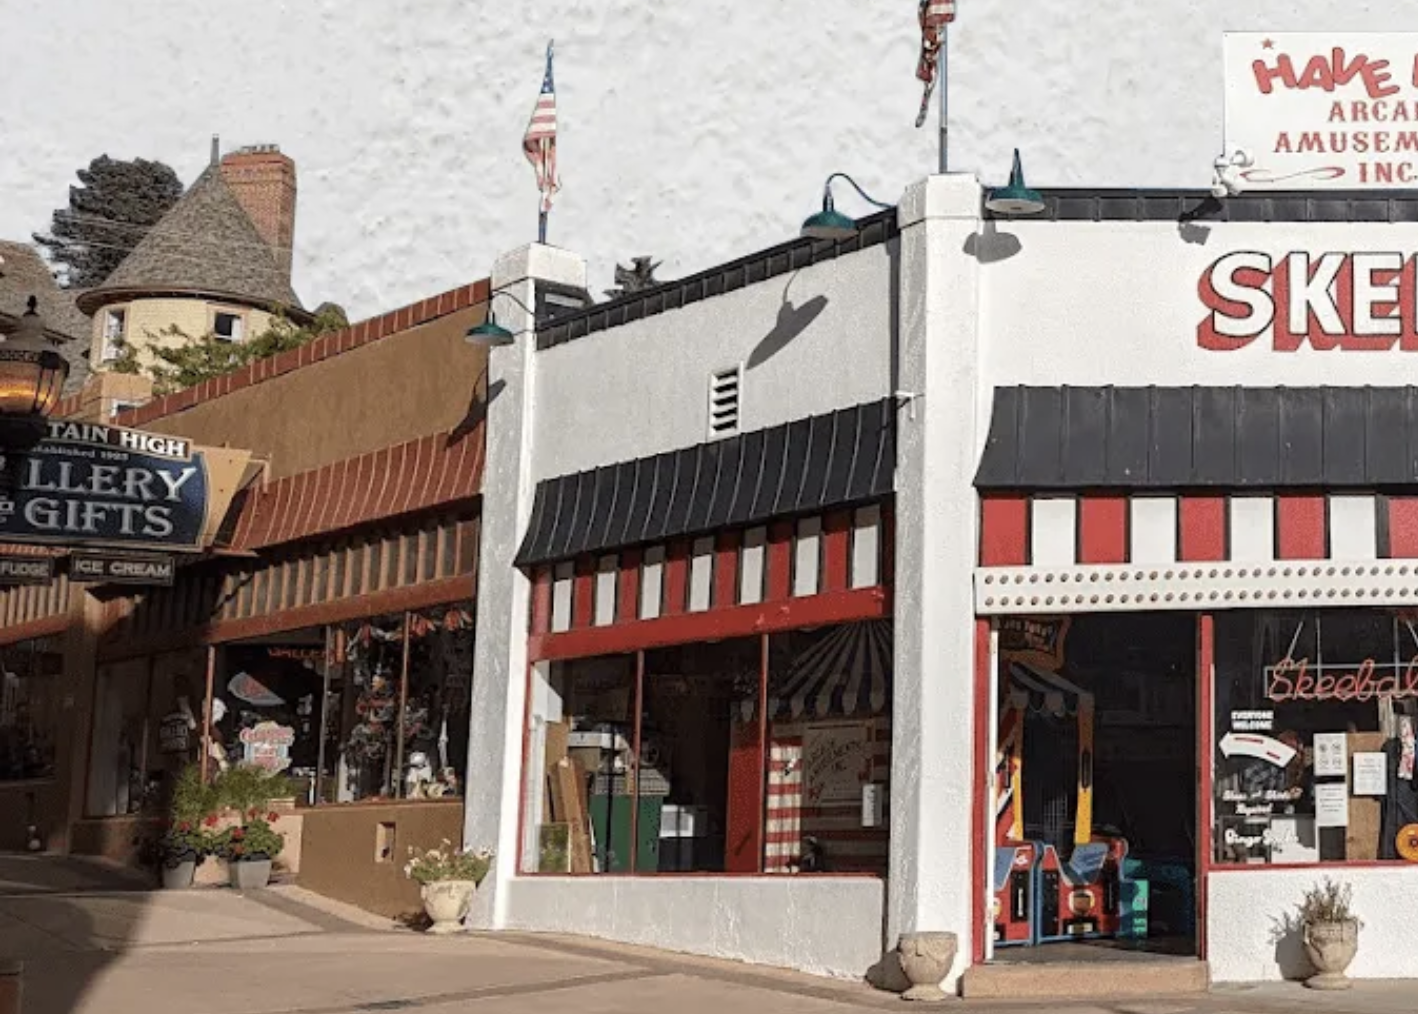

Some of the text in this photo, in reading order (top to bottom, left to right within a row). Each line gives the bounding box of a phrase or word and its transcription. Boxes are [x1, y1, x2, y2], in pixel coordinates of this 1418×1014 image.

[1252, 46, 1400, 99] HAVE
[1359, 162, 1418, 183] INC.
[48, 422, 186, 457] TAIN HIGH
[23, 458, 197, 502] LLERY
[24, 497, 173, 536] GIFTS
[1, 561, 49, 577] FUDGE
[75, 560, 172, 577] ICE CREAM
